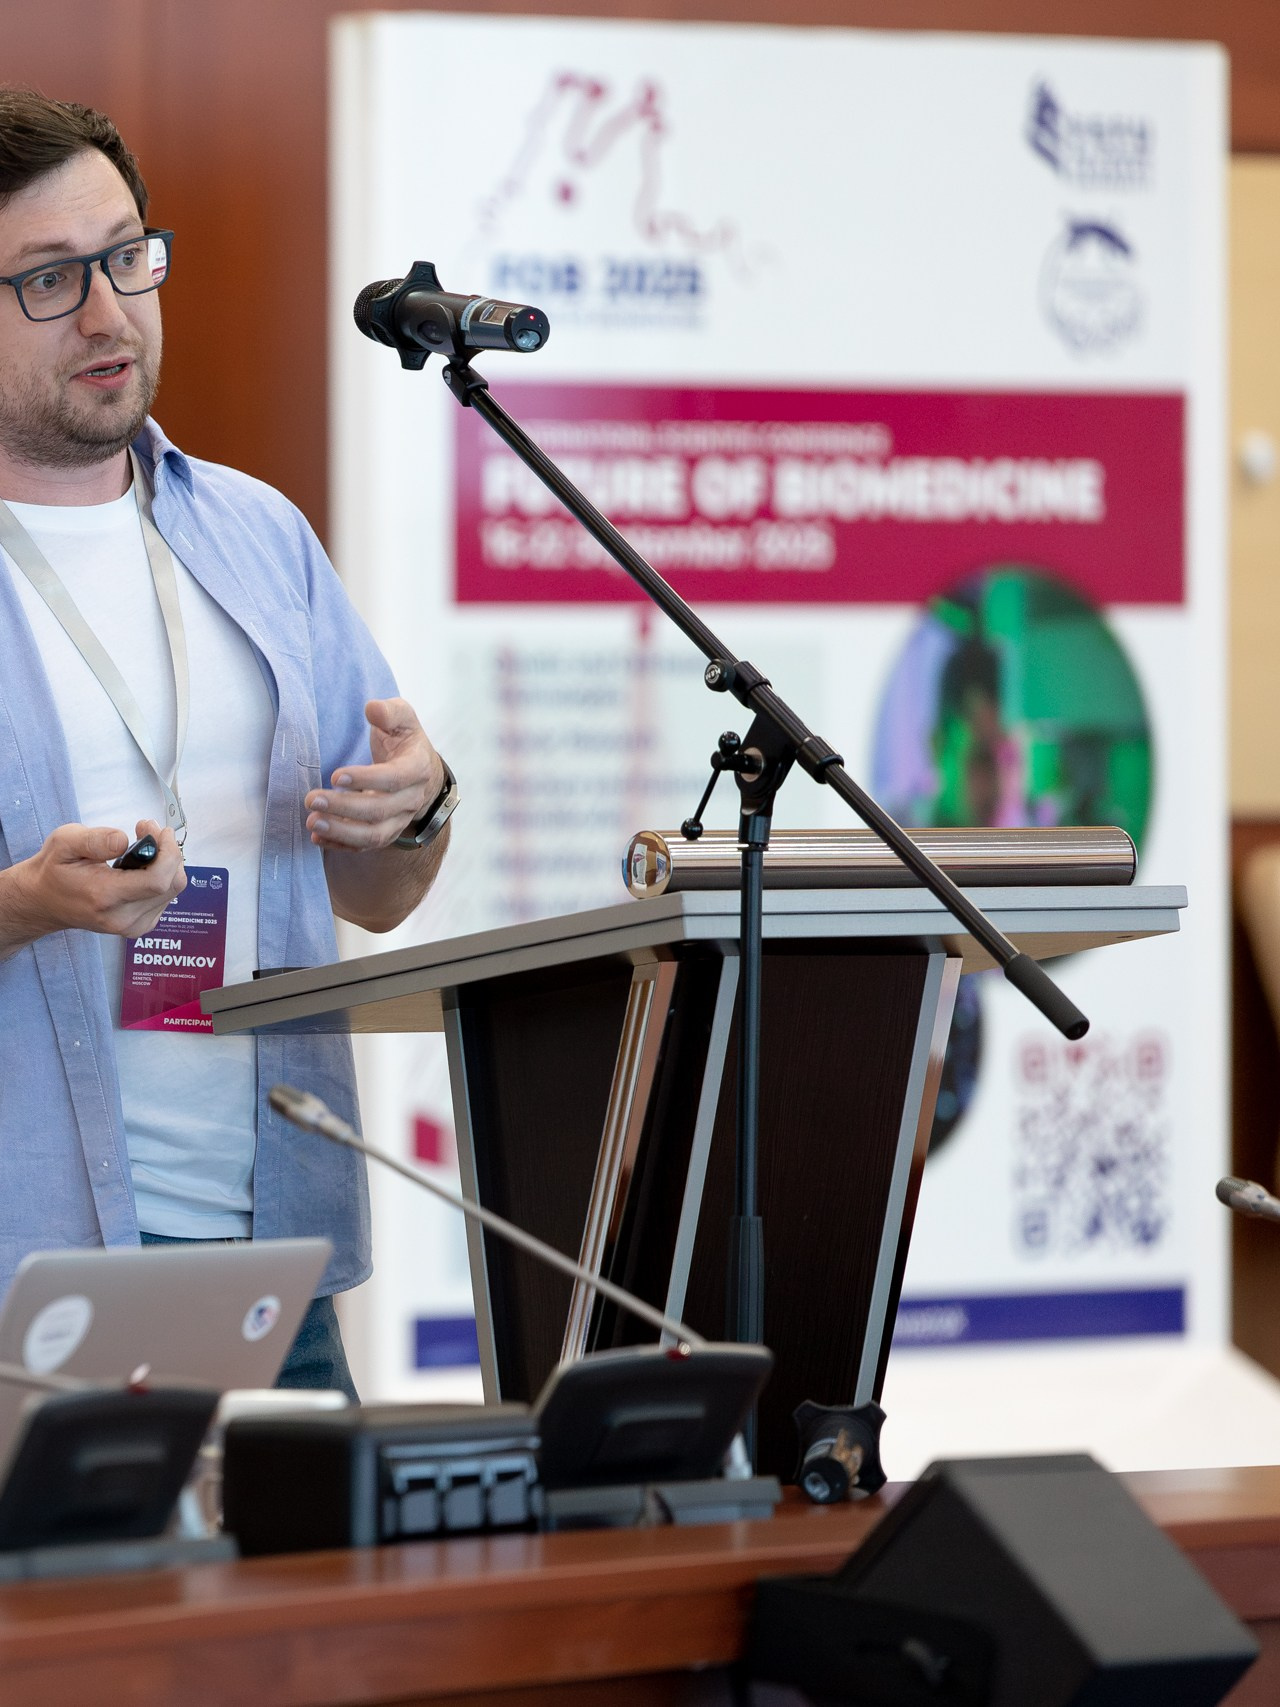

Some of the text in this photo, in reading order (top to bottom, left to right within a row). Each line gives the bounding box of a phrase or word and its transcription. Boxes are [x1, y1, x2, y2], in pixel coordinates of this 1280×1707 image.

[490, 254, 584, 298] FOB
[482, 455, 1106, 524] FUTURE OF BIOMEDICINE
[134, 937, 182, 950] ARTEM
[133, 953, 217, 968] BOROVIKOV
[163, 1017, 213, 1027] PARTICIPAN
